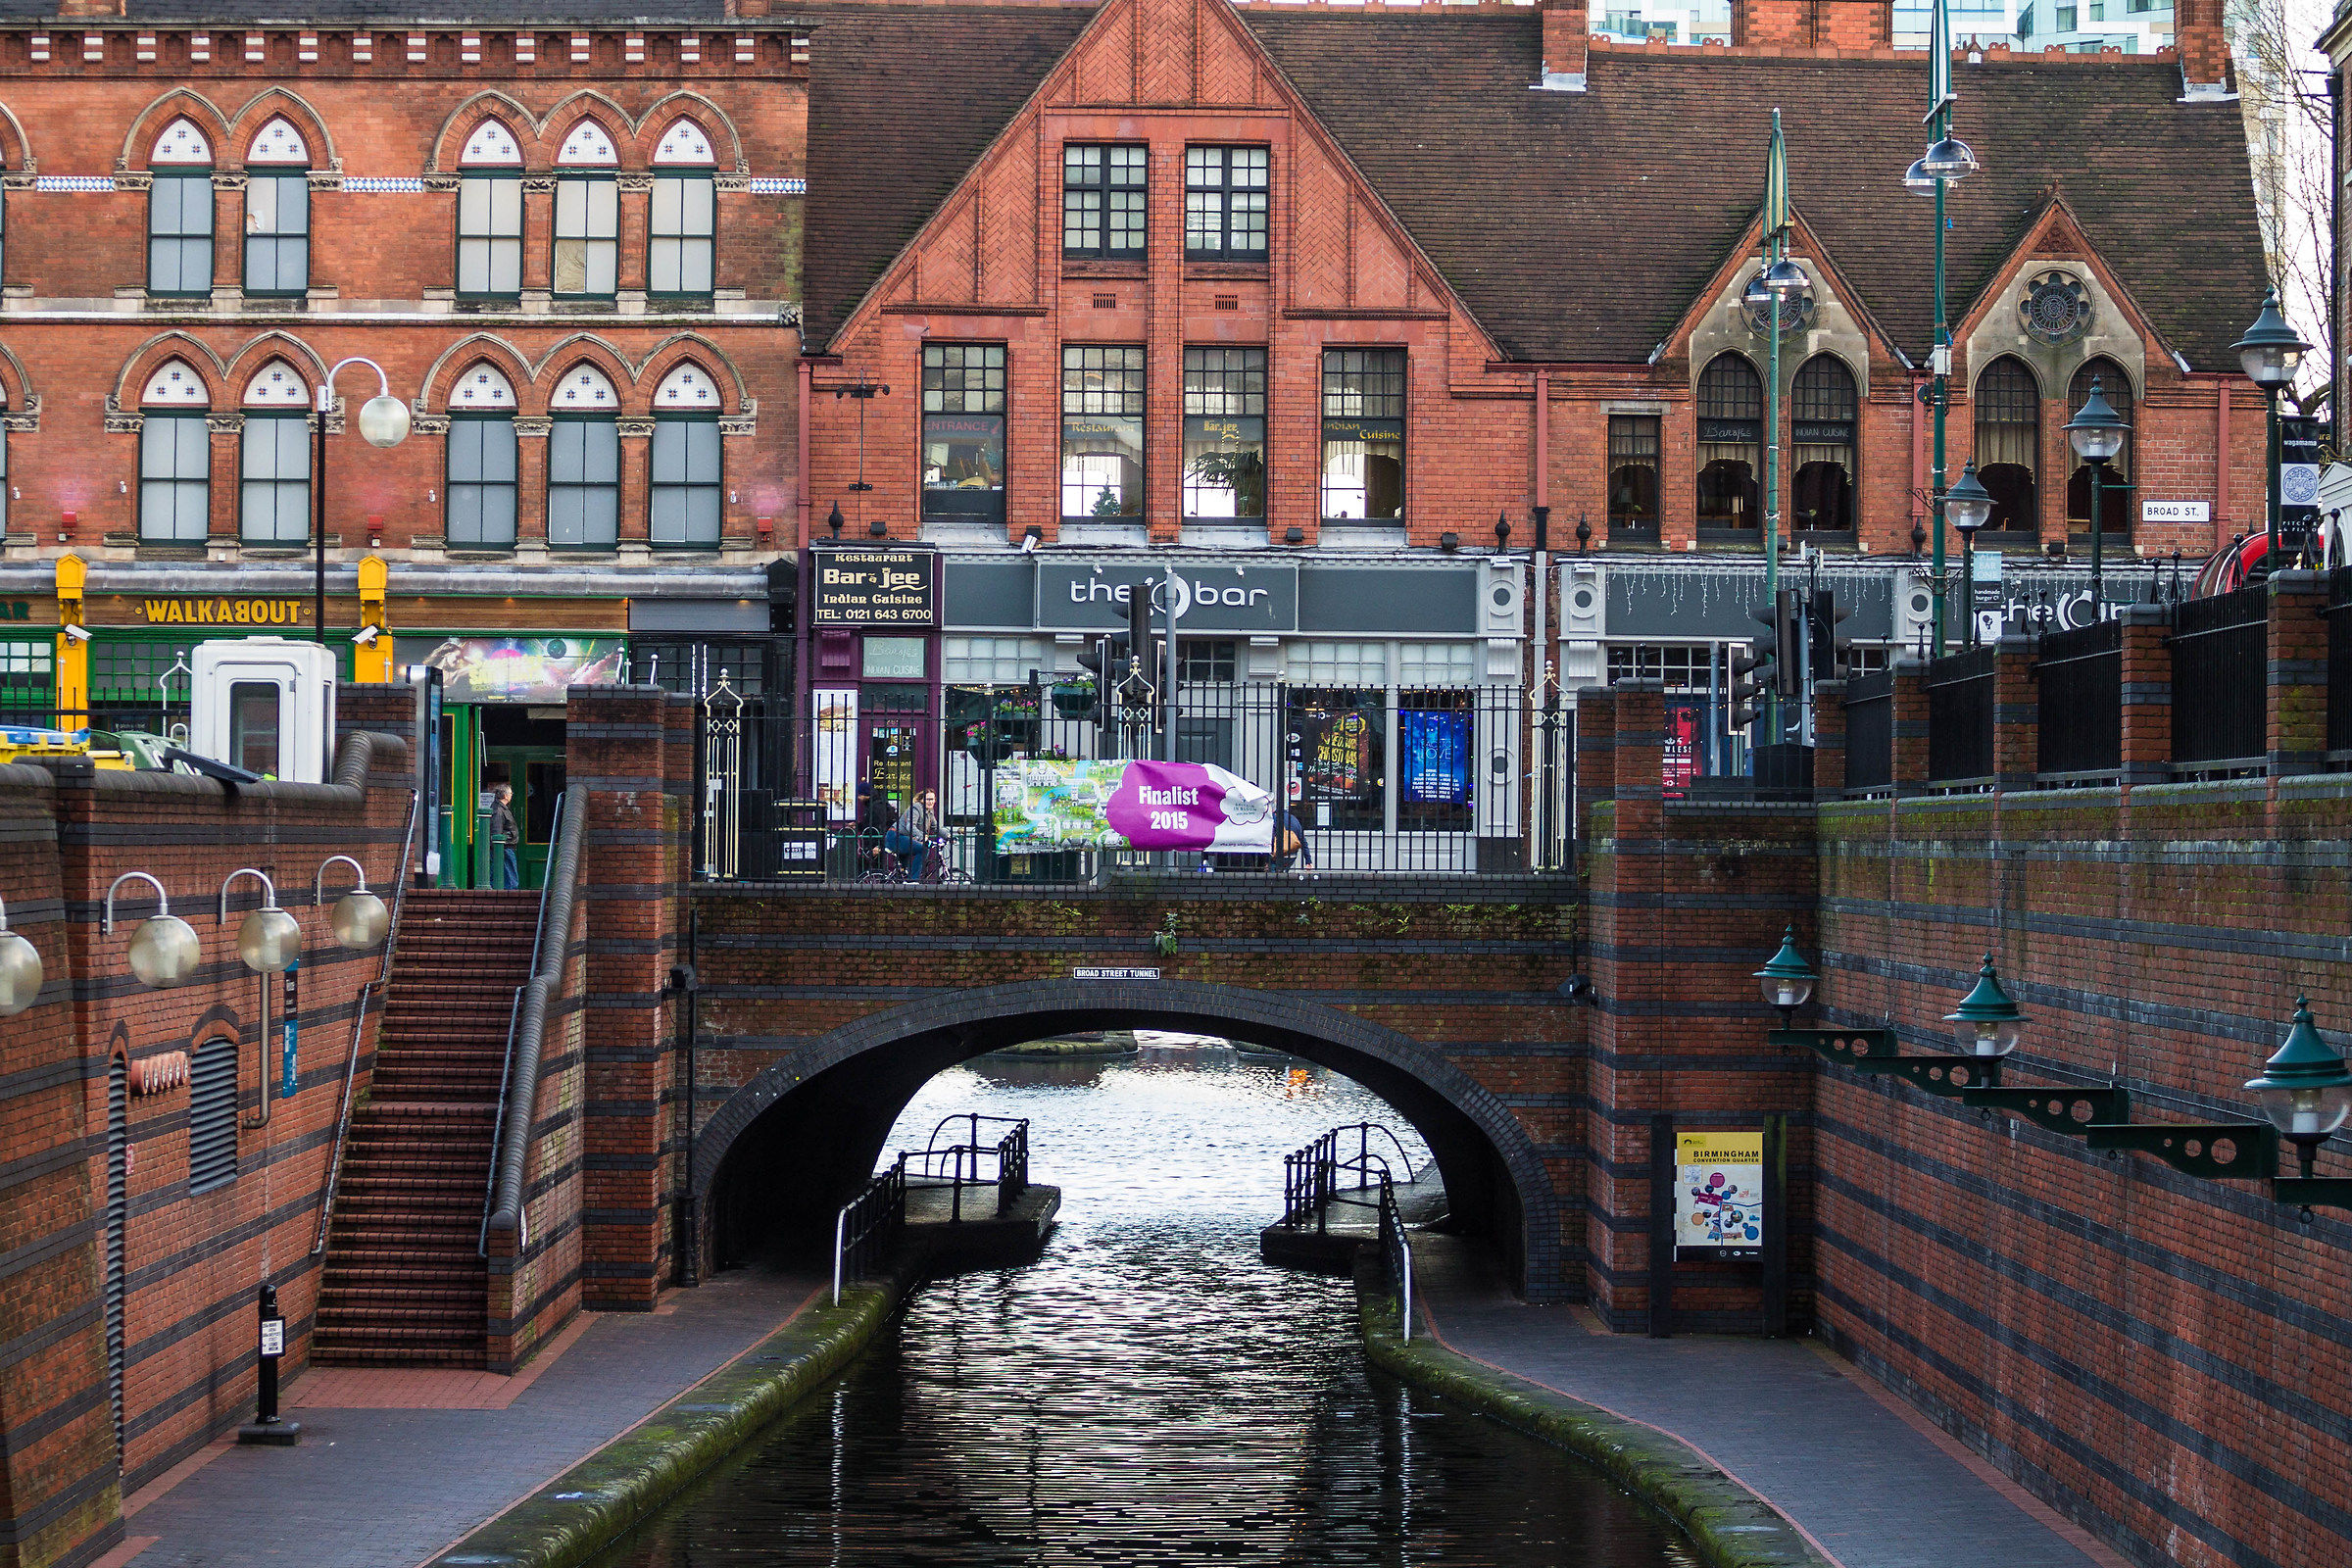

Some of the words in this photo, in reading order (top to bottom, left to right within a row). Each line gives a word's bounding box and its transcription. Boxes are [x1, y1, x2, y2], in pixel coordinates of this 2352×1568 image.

[924, 420, 988, 432] ENTRANCE
[1071, 422, 1135, 432] Restaurant
[1359, 429, 1401, 440] Cuisine
[2283, 438, 2318, 447] wagamama
[2147, 507, 2180, 515] BROAD
[1070, 577, 1130, 603] the
[1195, 580, 1269, 607] bar
[823, 594, 867, 604] Indian
[872, 594, 923, 605] Cuisine
[144, 600, 302, 623] WALKABOUT
[817, 609, 842, 619] TEL:
[846, 609, 870, 619] 0121
[875, 609, 897, 619] 643
[902, 609, 931, 619] 6700
[866, 665, 891, 675] INDIAN
[893, 665, 920, 675] CUISINE
[1138, 785, 1200, 806] Finalist
[1150, 811, 1189, 830] 2015
[1129, 969, 1156, 978] TUNNEL
